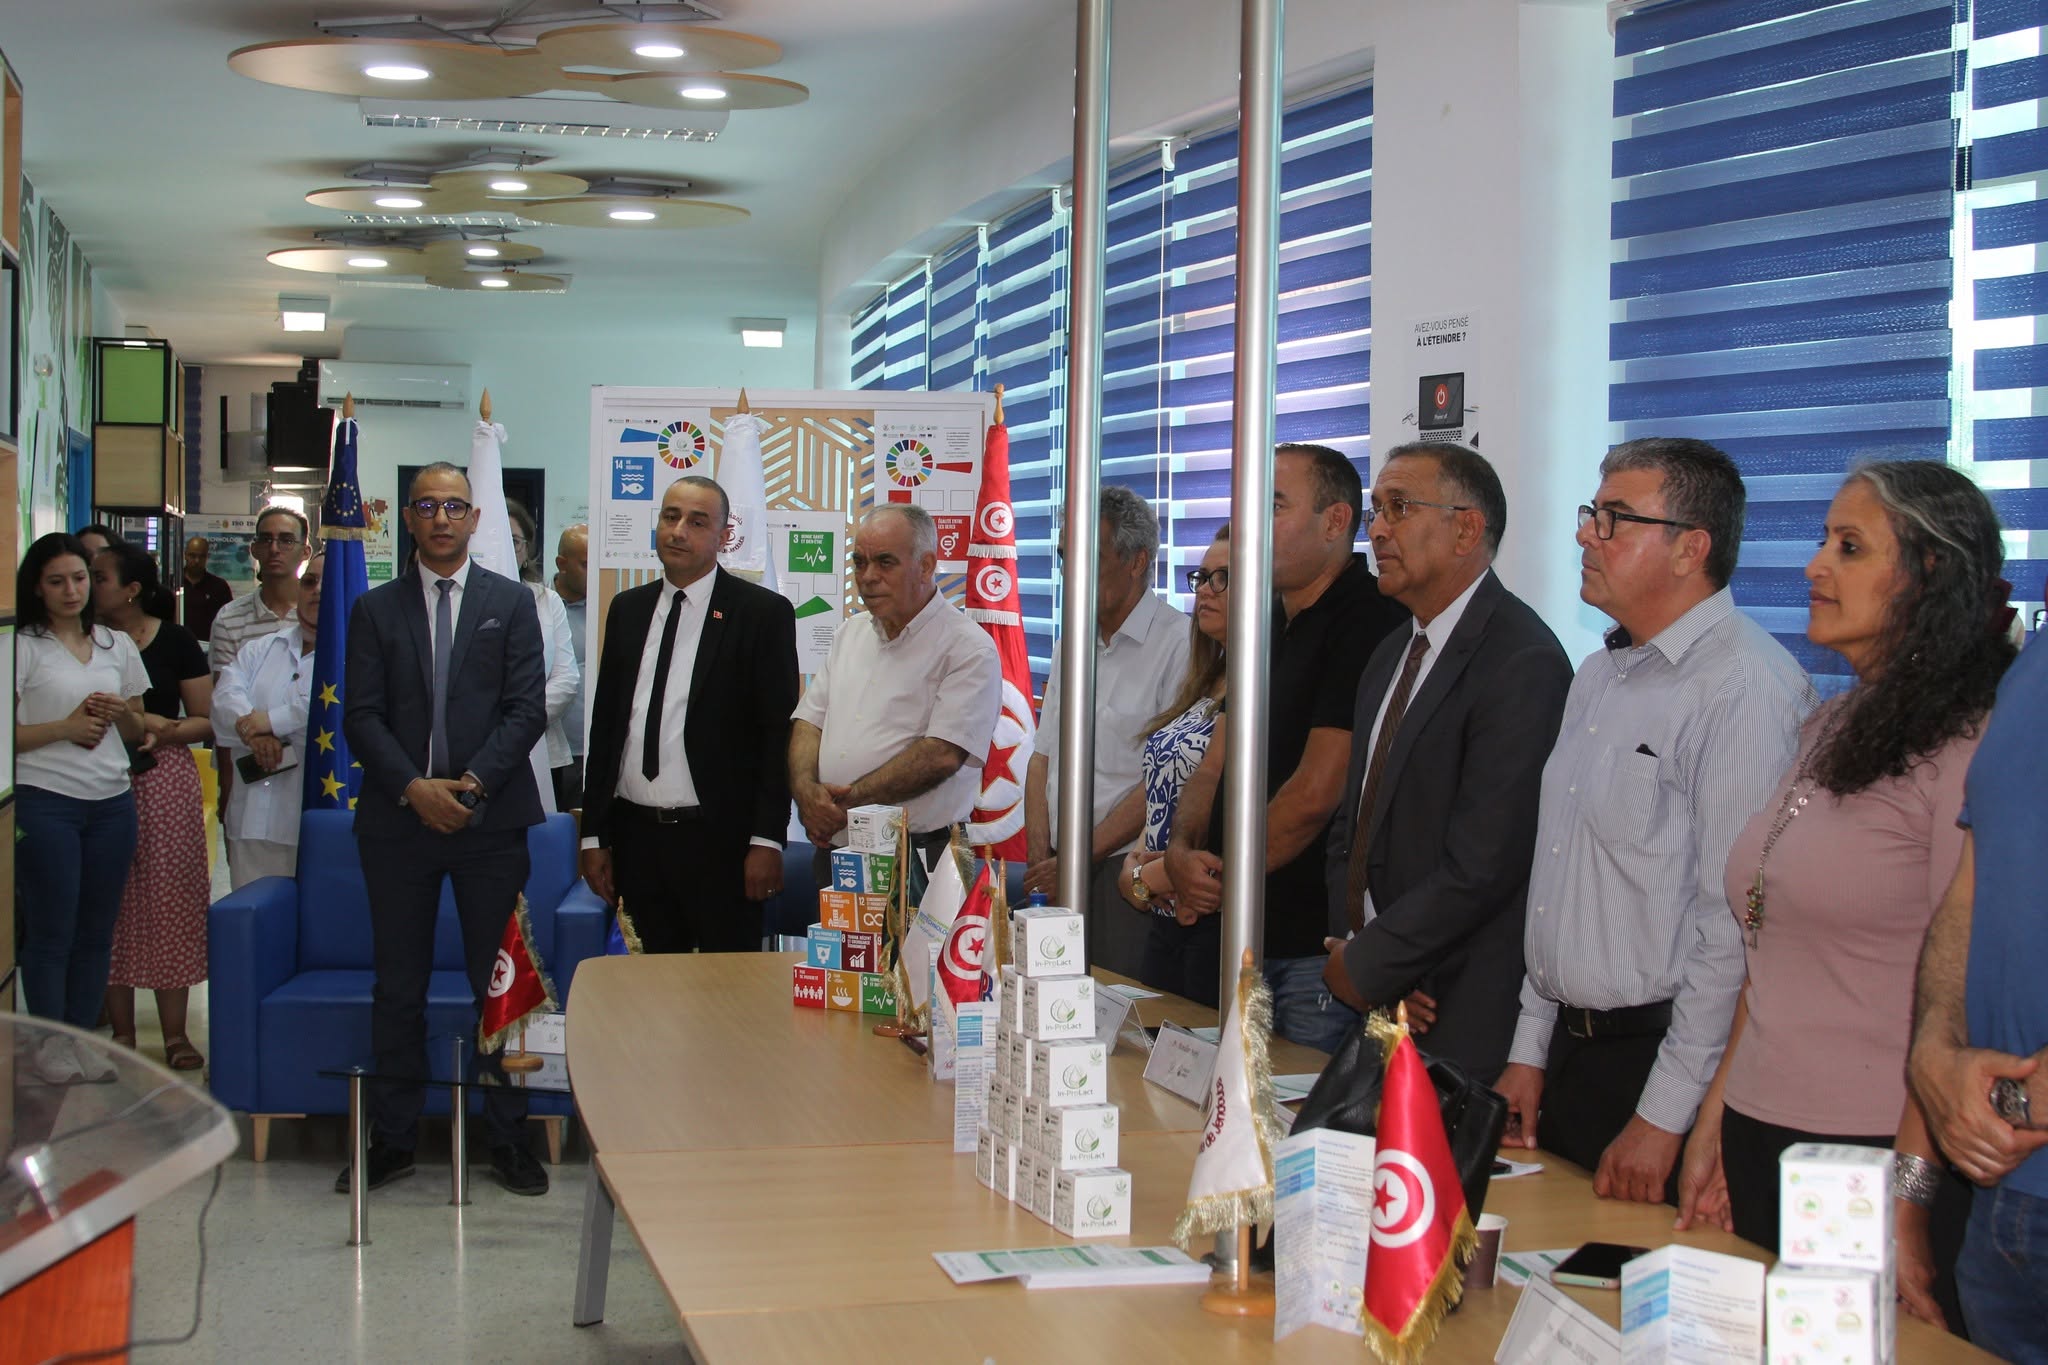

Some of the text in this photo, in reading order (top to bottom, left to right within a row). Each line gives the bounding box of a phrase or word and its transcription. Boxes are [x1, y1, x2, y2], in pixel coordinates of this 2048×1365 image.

[1414, 315, 1469, 333] AVEZ-VOUS PENSÉ
[1416, 331, 1467, 347] À L'ÉTEINDRE ?
[614, 459, 623, 470] 14
[793, 534, 799, 544] 3
[833, 856, 839, 865] 14
[822, 894, 827, 902] 11
[859, 897, 865, 906] 12
[842, 934, 846, 943] 8
[1035, 959, 1071, 968] In-ProLact
[863, 977, 868, 986] 3
[1046, 1023, 1082, 1031] In-ProLact
[1057, 1089, 1093, 1097] In-ProLact
[1069, 1152, 1105, 1161] In-ProLact
[1081, 1219, 1117, 1227] In-ProLact
